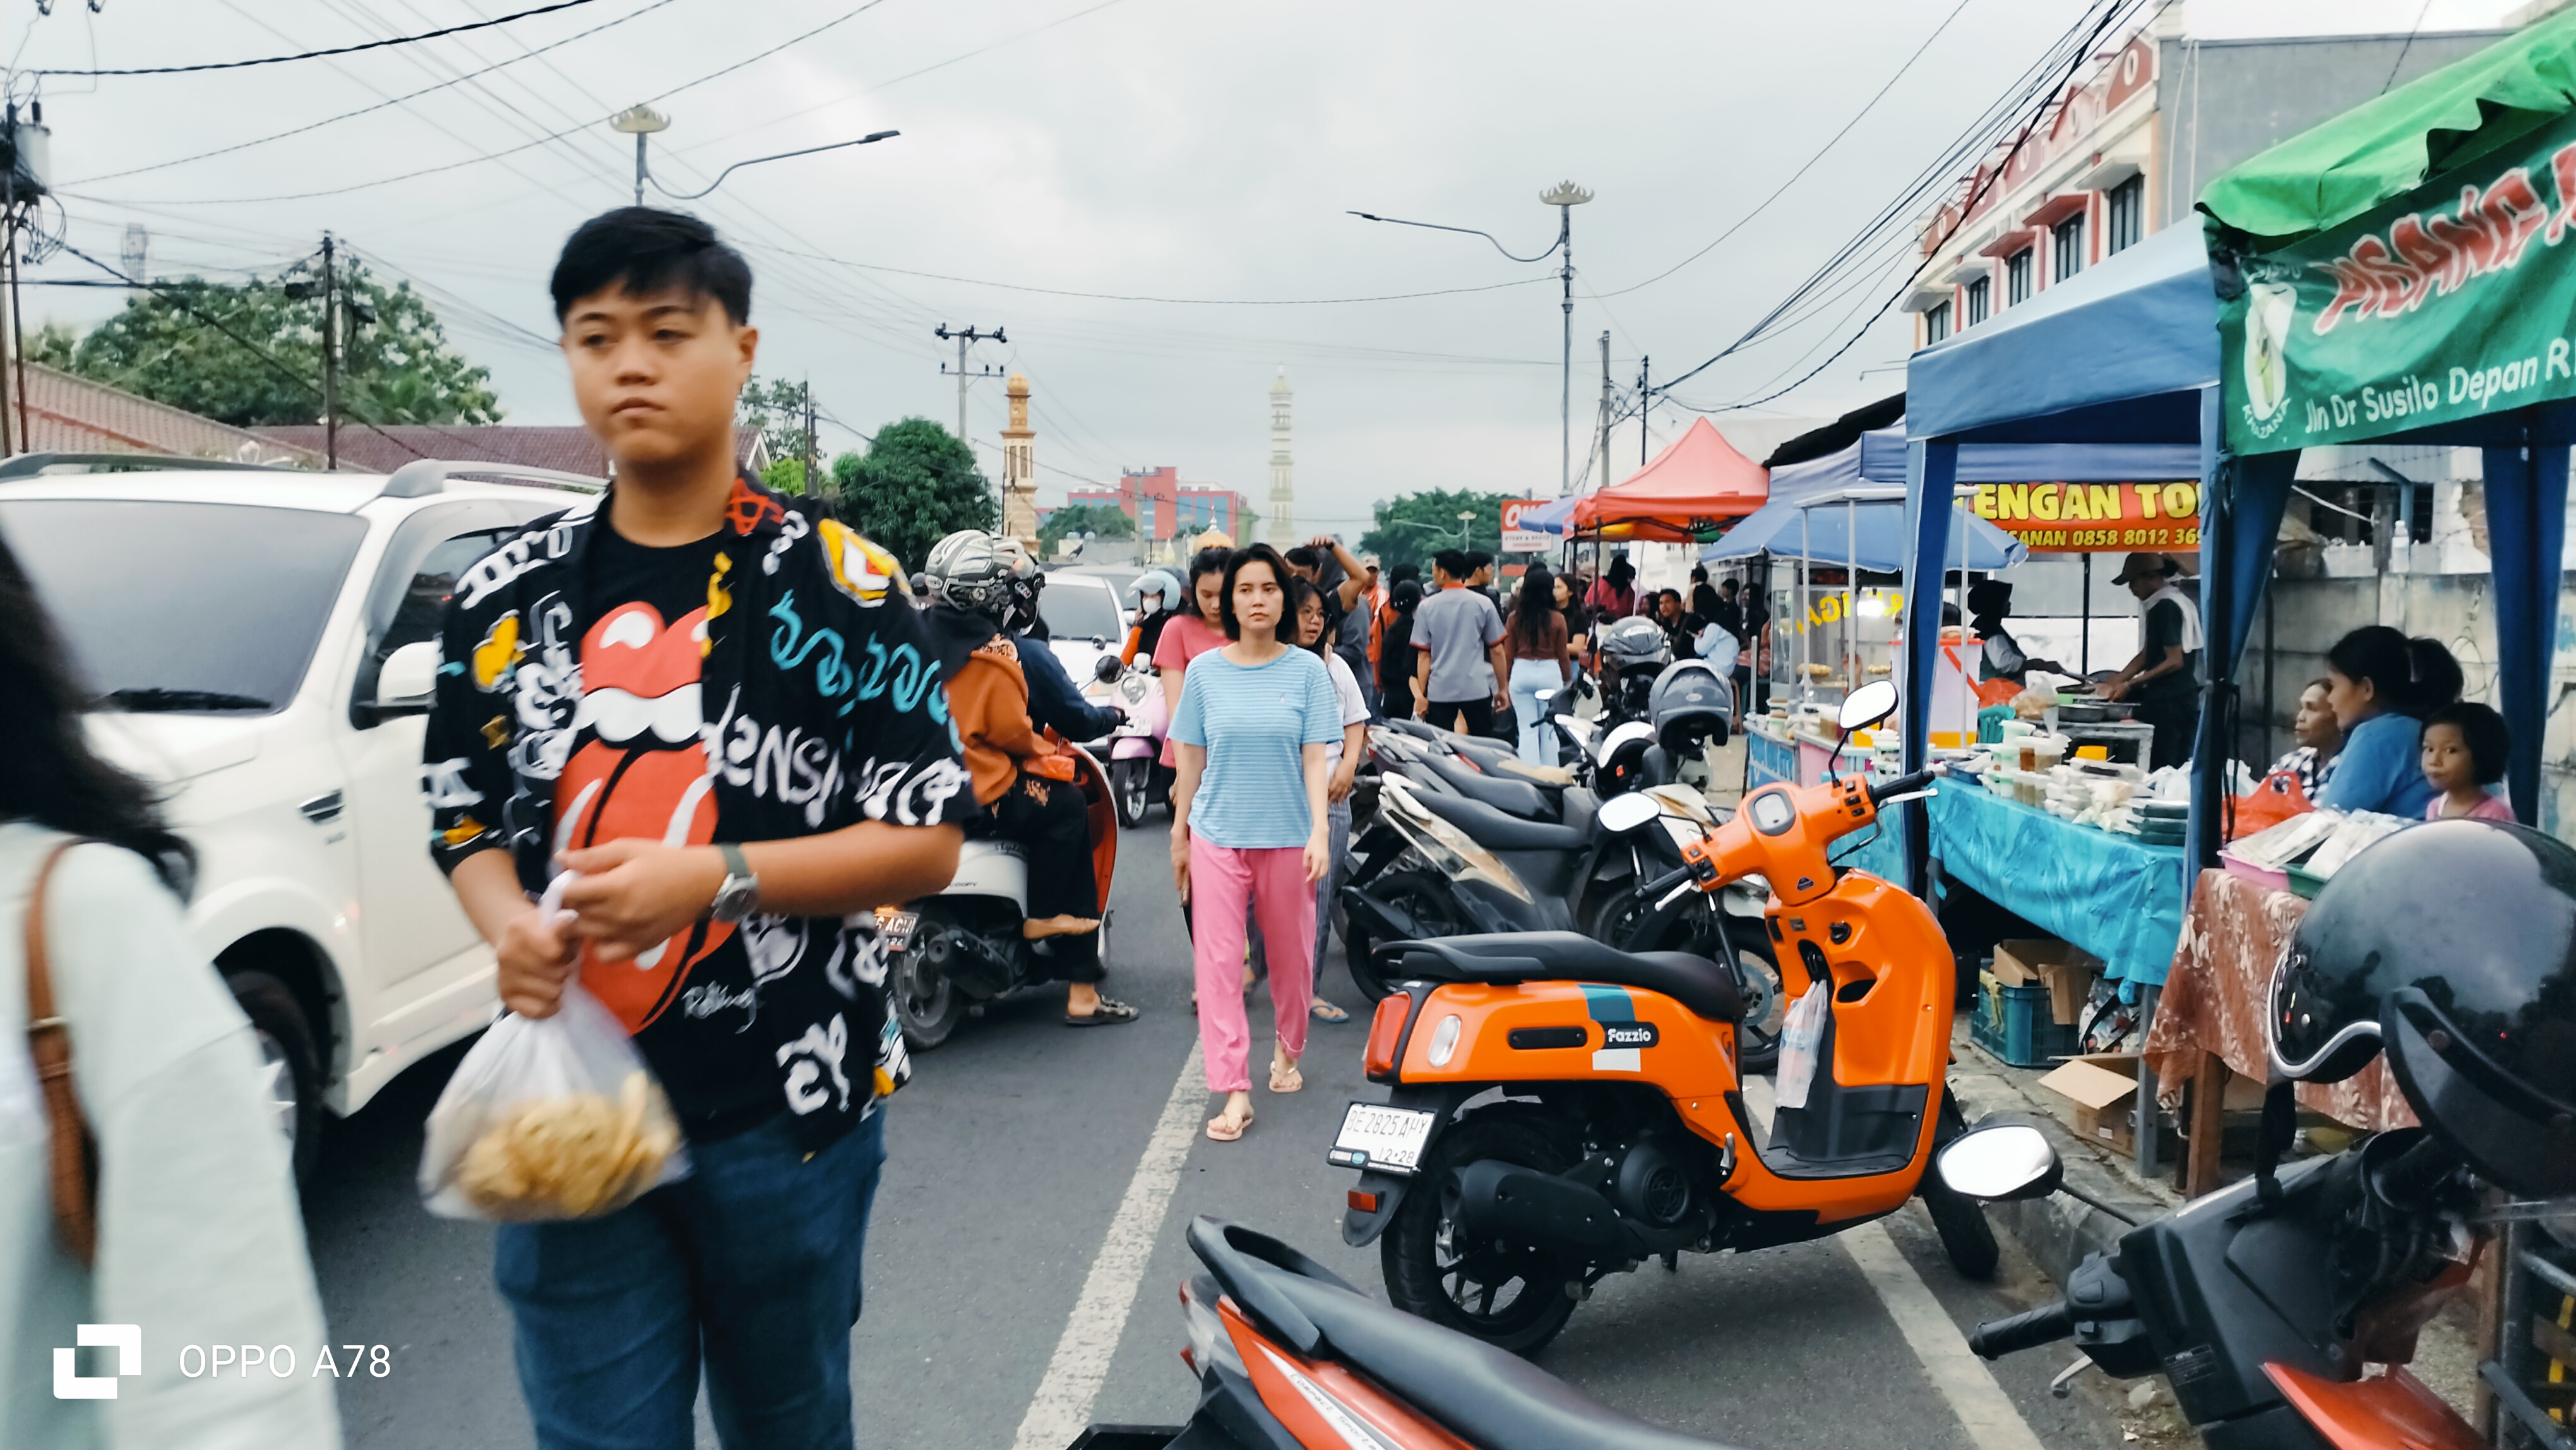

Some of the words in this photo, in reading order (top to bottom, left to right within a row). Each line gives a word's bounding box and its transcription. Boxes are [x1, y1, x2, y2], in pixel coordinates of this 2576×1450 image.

[2305, 398, 2330, 433] Jln
[2330, 395, 2357, 428] Dr
[2362, 374, 2438, 422] Susilo
[2448, 357, 2538, 409] Depan
[2546, 337, 2576, 381] R
[2135, 482, 2202, 518] TO
[2072, 529, 2118, 546] 0858
[2123, 529, 2168, 545] 8012
[1607, 1028, 1651, 1042] Fazzio
[1346, 1110, 1366, 1132] BE
[1364, 1113, 1400, 1135] 2825
